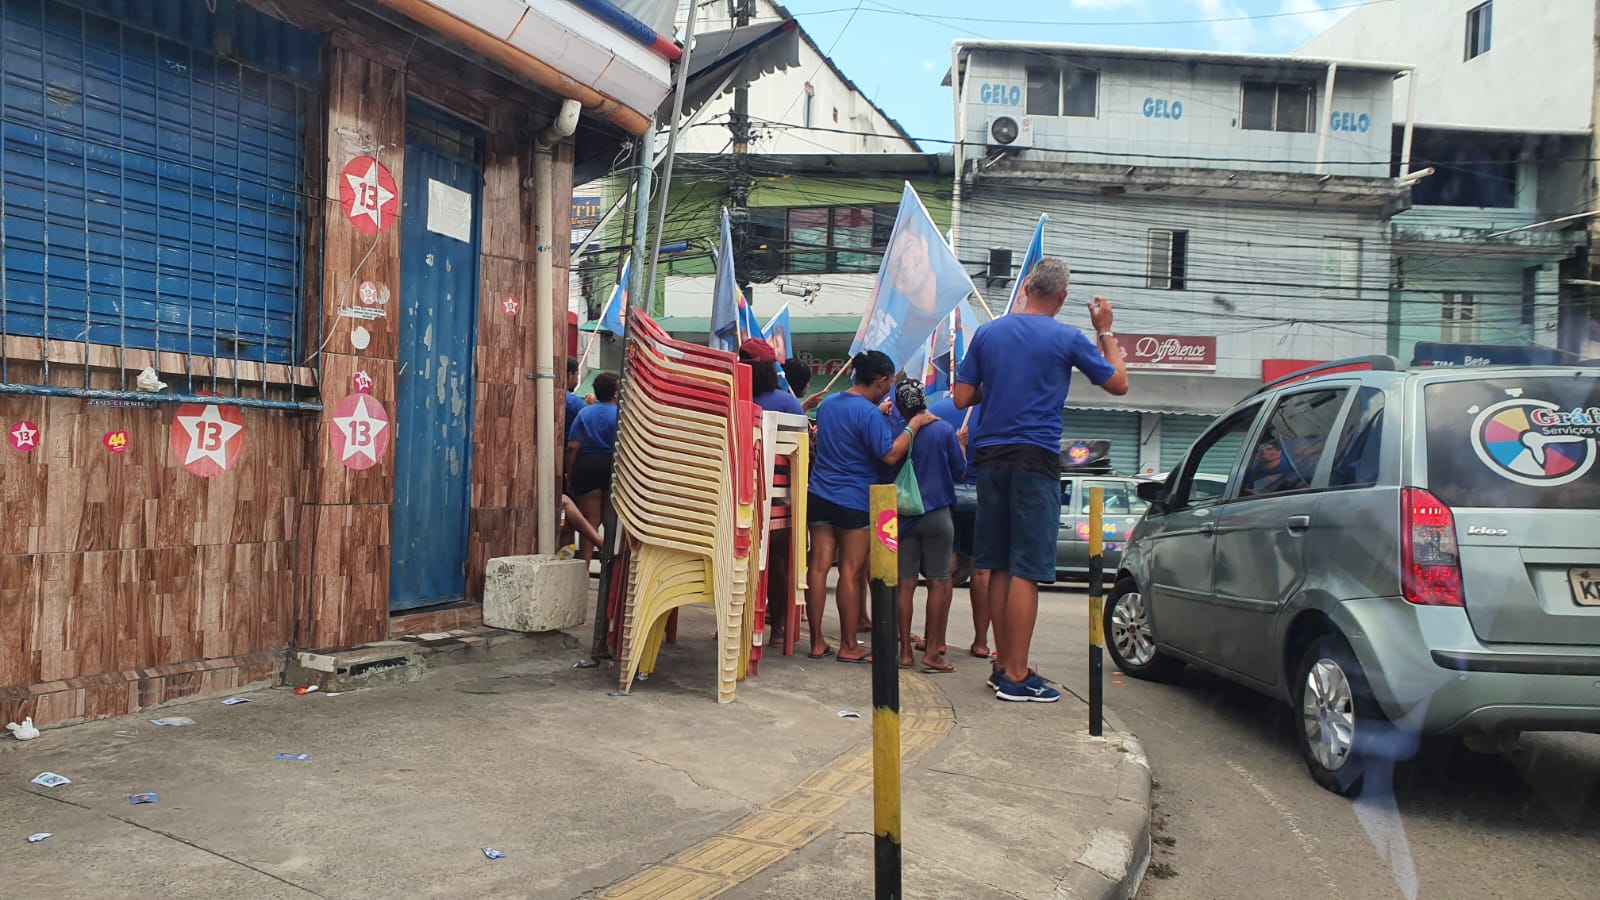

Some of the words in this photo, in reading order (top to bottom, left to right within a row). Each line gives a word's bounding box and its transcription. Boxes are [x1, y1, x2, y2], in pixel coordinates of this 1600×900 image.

[980, 83, 1021, 106] GELO
[1142, 97, 1184, 120] GELO
[1329, 110, 1371, 133] GELO
[359, 182, 379, 211] 13
[1134, 336, 1206, 363] Difference
[1530, 407, 1600, 426] Gráf
[20, 431, 31, 441] 13
[108, 433, 126, 446] 44
[195, 420, 223, 452] 13
[348, 420, 372, 447] 13
[1542, 427, 1594, 436] Serviços
[882, 516, 898, 540] 4
